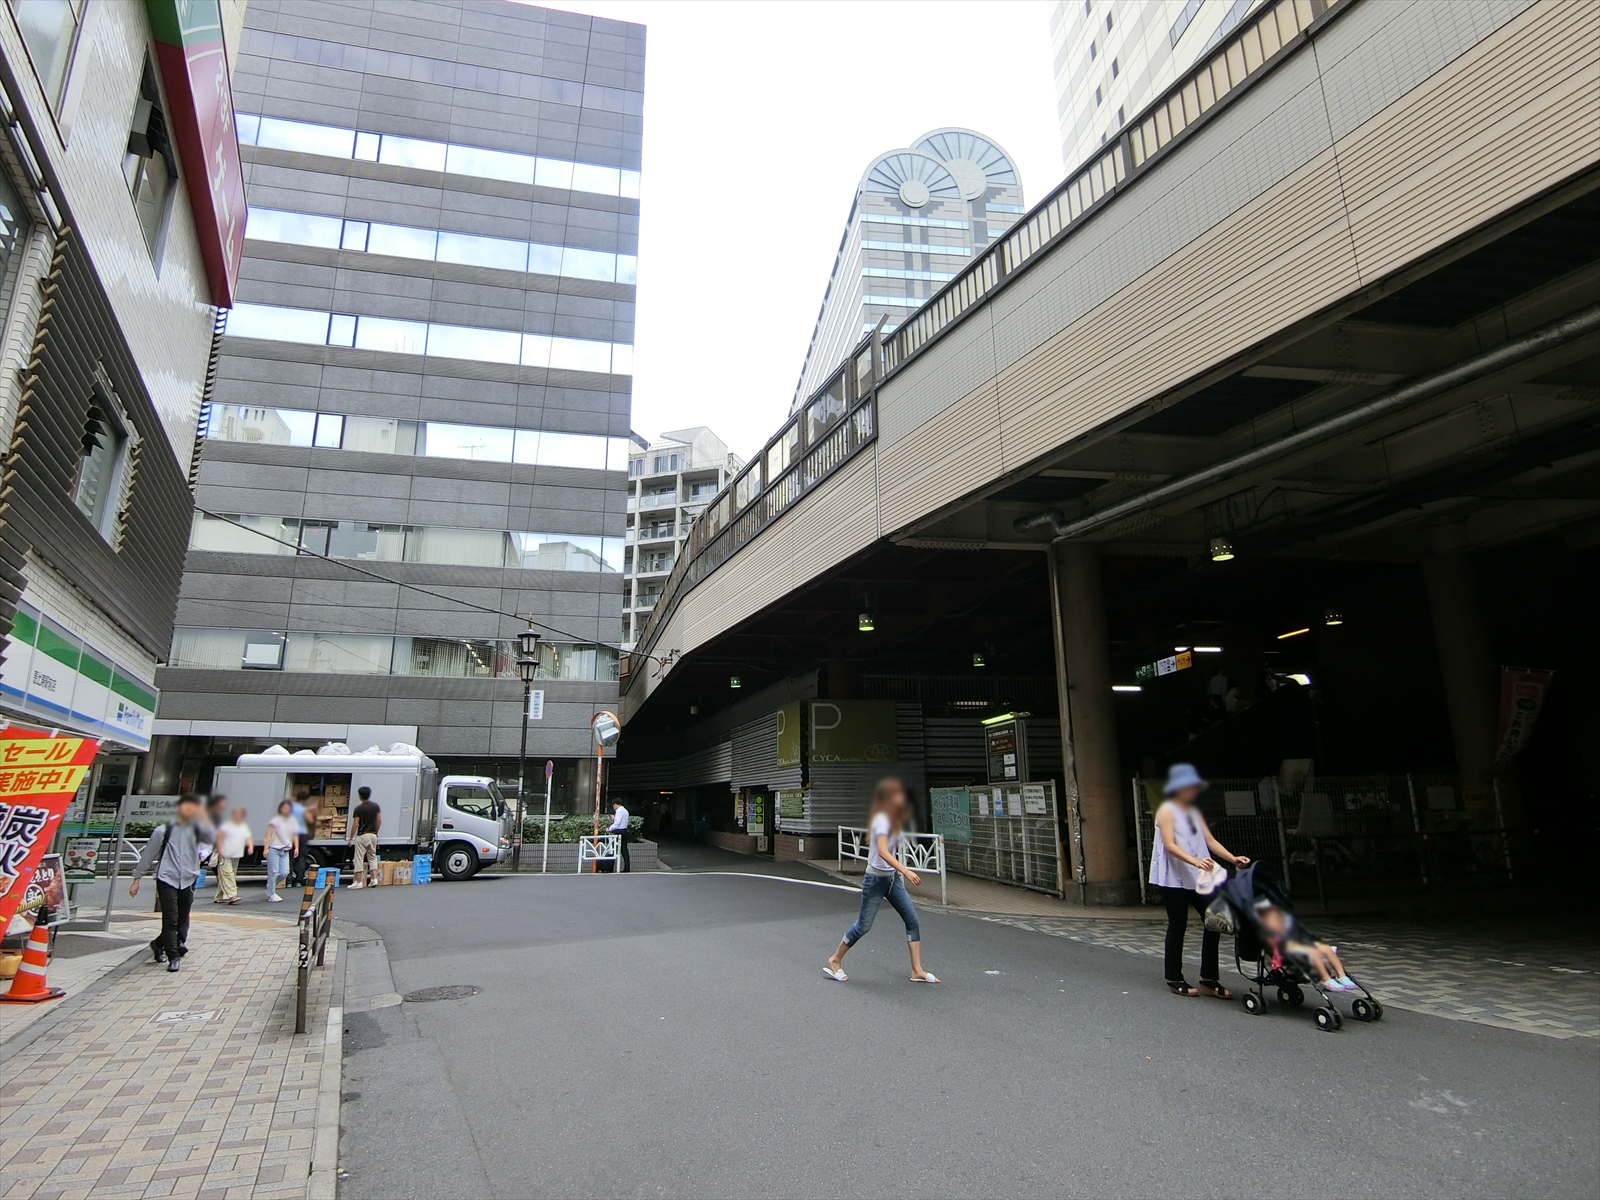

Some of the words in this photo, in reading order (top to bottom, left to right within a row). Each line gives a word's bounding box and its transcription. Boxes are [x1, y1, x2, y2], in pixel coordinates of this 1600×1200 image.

[777, 709, 786, 755] P
[811, 702, 842, 750] P
[4, 742, 72, 763] セール
[812, 754, 841, 762] CYCA
